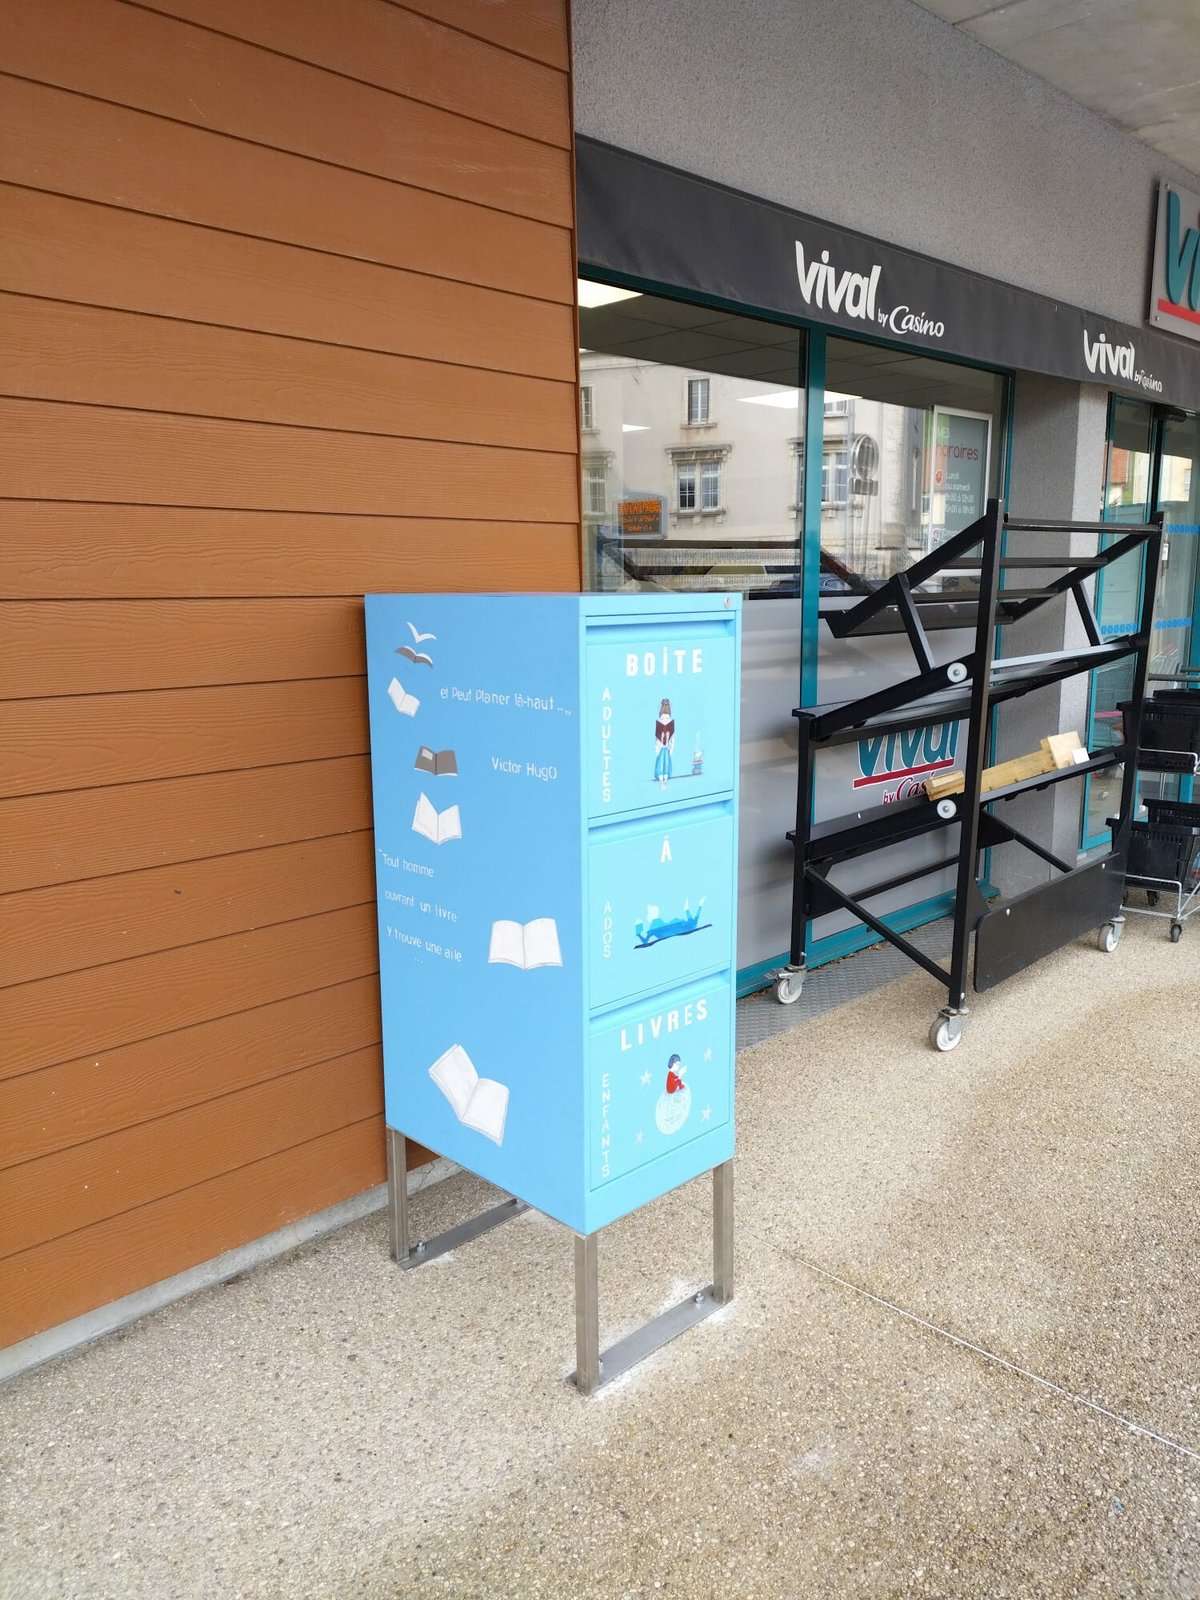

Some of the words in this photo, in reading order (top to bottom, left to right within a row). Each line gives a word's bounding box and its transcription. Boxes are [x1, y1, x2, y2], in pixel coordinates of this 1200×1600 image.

[878, 308, 889, 328] by
[889, 305, 945, 338] Casino
[936, 443, 979, 460] horaires
[602, 687, 612, 802] ADULTES
[491, 756, 522, 775] Victor
[403, 858, 434, 878] homme
[384, 890, 415, 907] ouvrant
[420, 901, 431, 913] un
[435, 904, 458, 923] livre
[386, 924, 392, 937] y
[395, 929, 422, 948] trouve
[425, 941, 442, 955] une
[445, 948, 462, 962] aile
[603, 899, 613, 958] ADOS
[620, 999, 708, 1051] LIVRES
[602, 1072, 611, 1178] ENFANTS
